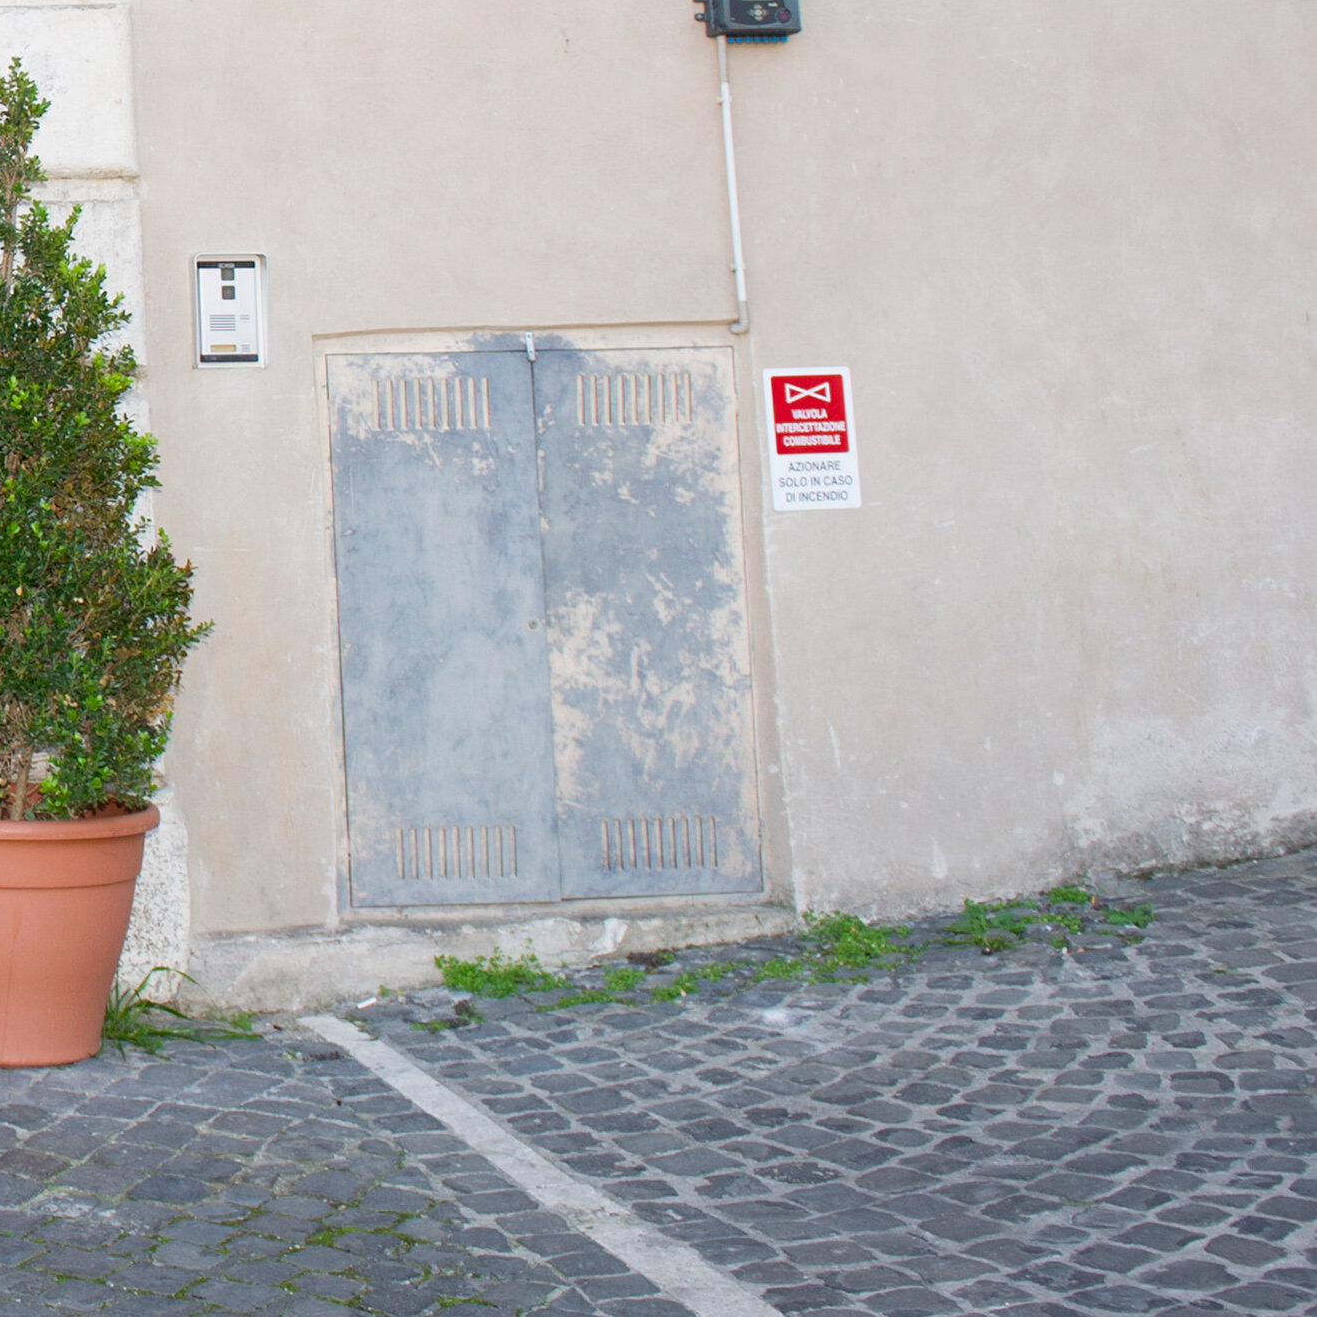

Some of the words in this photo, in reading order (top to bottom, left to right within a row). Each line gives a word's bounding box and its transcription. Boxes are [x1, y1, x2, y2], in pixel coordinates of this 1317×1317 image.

[792, 408, 828, 419] VALVOLA
[775, 421, 846, 433] INTERCETTAZIONE
[783, 434, 841, 446] COMBUSTIBILE
[788, 460, 841, 472] AZIONARE
[778, 476, 808, 488] SOLO
[810, 476, 821, 486] IN
[823, 474, 853, 486] CASO
[785, 491, 796, 503] DI
[798, 490, 849, 502] INCENDIO
